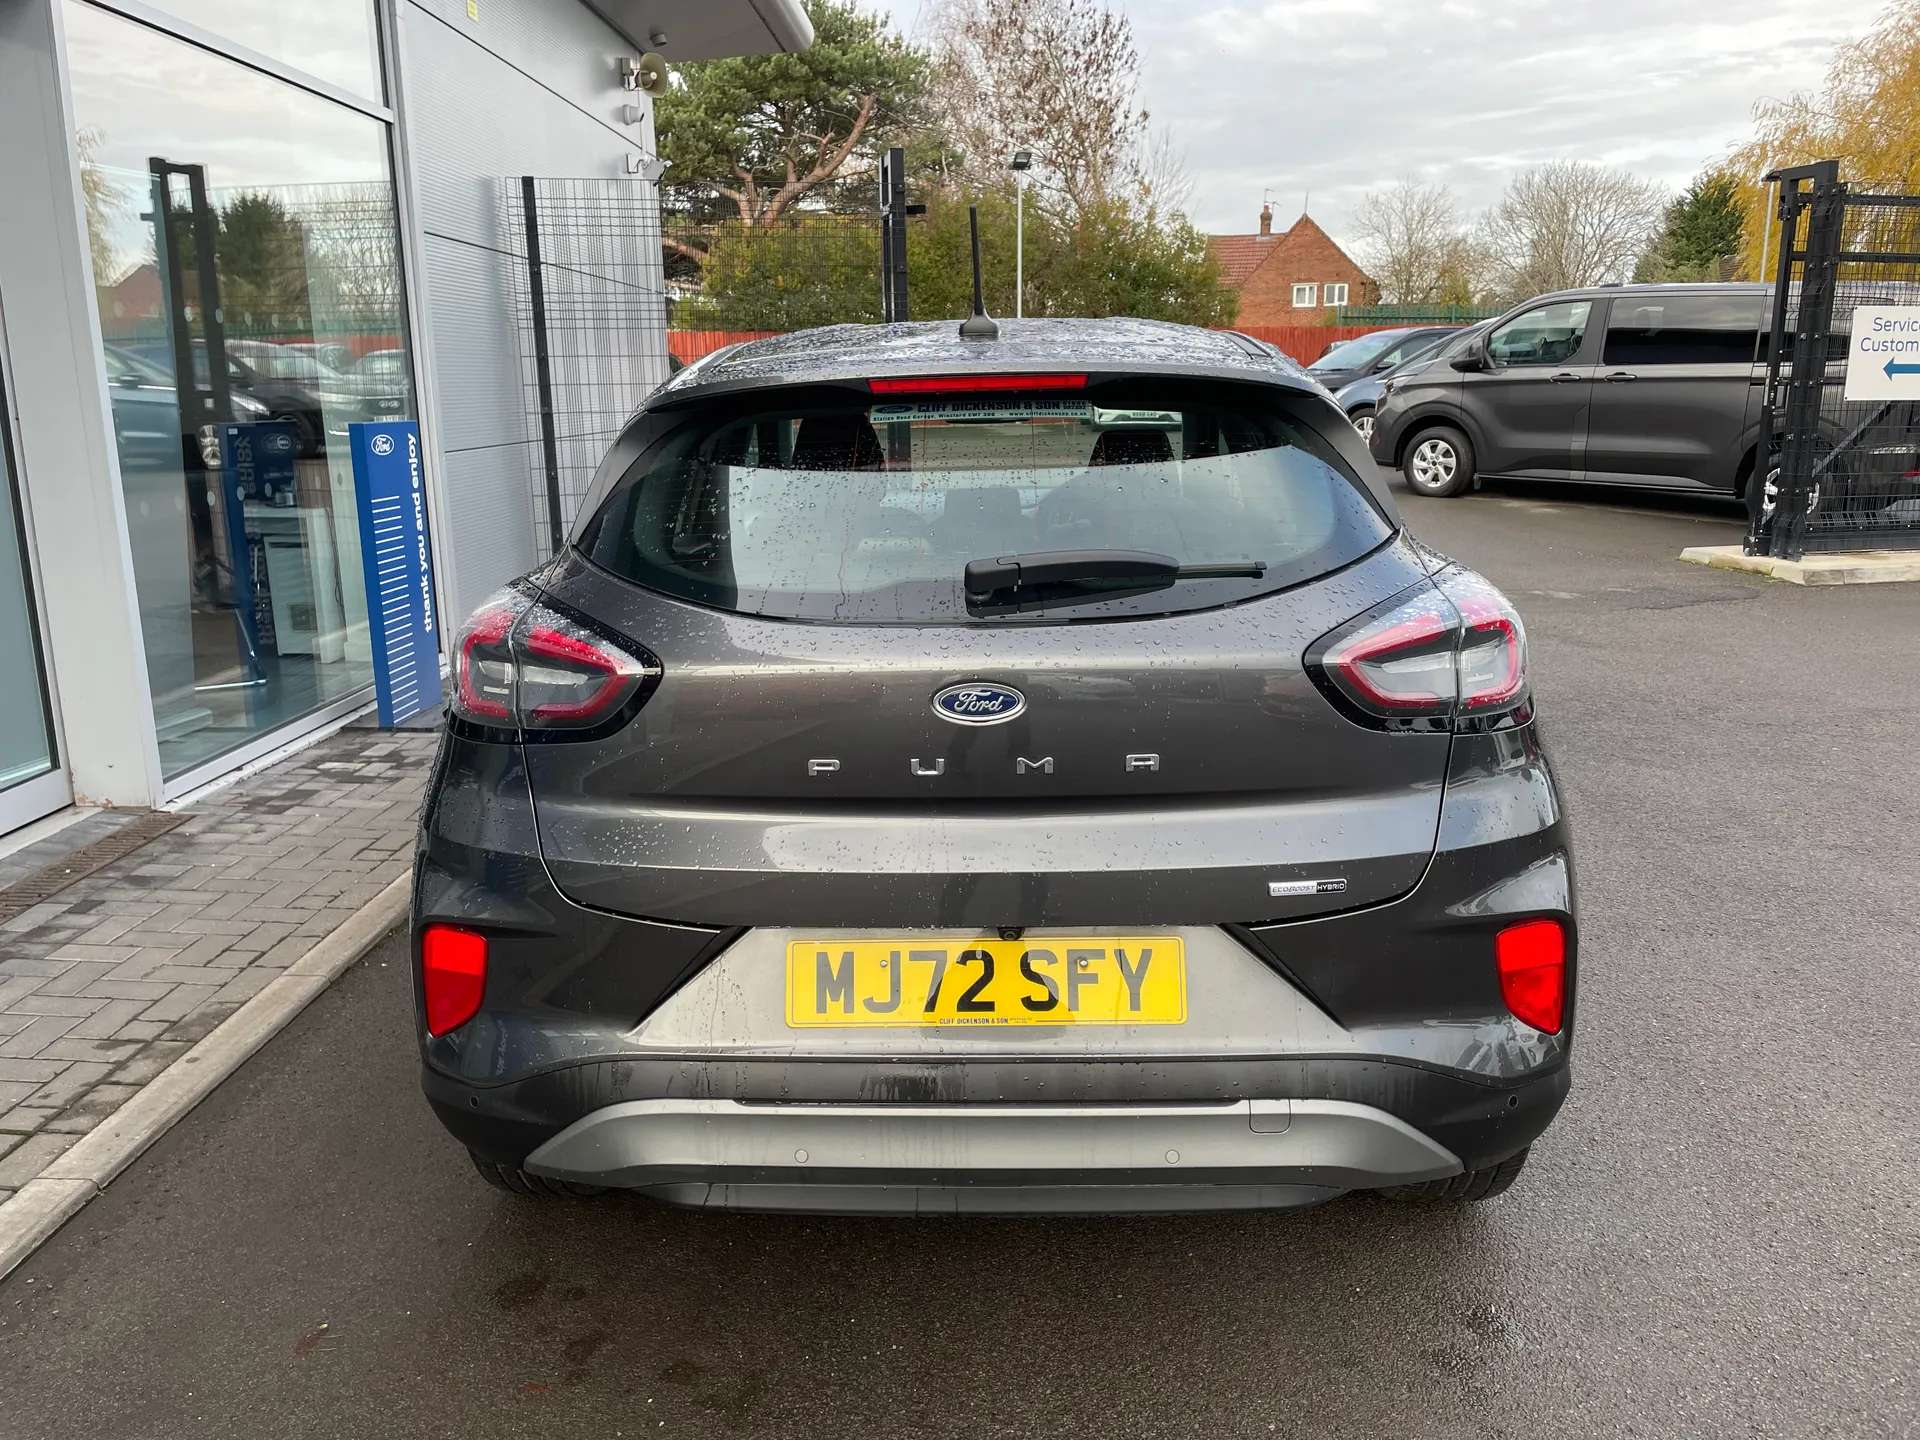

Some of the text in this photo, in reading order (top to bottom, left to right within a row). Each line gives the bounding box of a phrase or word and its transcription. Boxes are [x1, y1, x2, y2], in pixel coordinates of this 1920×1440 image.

[1872, 316, 1920, 332] Servic
[917, 402, 946, 412] CLIFF
[951, 400, 1021, 411] DICKENSON
[1035, 400, 1060, 410] SON
[407, 433, 432, 633] thank you and enjoy
[808, 753, 1161, 777] PUMA
[1317, 882, 1345, 891] HYBRID
[815, 949, 1154, 1014] MJ72 SFY
